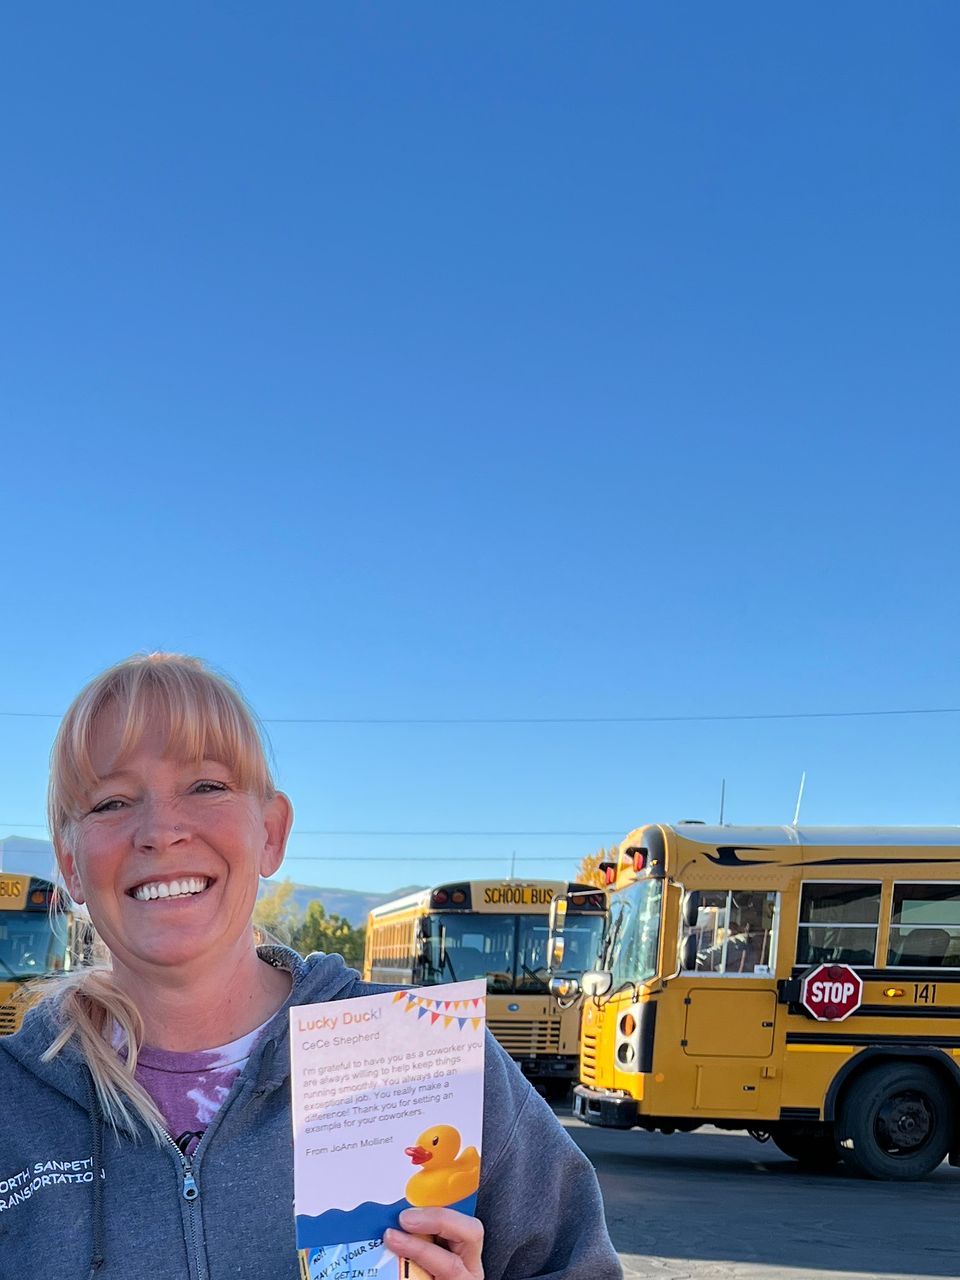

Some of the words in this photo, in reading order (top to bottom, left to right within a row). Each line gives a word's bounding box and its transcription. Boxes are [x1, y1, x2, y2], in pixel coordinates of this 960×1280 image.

[0, 881, 21, 897] BUS
[484, 887, 528, 904] SCHOOL
[531, 888, 554, 905] BUS
[811, 982, 855, 1004] STOP
[913, 984, 937, 1004] 141
[299, 1016, 338, 1031] Lucky
[343, 1008, 382, 1025] Duck!
[302, 1039, 330, 1051] CeCe
[333, 1032, 380, 1046] Shepherd
[318, 1061, 351, 1075] grateful
[353, 1060, 362, 1068] to
[363, 1057, 386, 1066] have
[387, 1055, 404, 1064] you
[406, 1052, 416, 1060] as
[426, 1044, 465, 1057] coworker
[303, 1080, 317, 1088] are
[319, 1073, 350, 1085] always
[352, 1069, 379, 1080] willing
[381, 1067, 390, 1075] to
[391, 1063, 410, 1074] help
[412, 1060, 433, 1071] keep
[435, 1055, 462, 1066] things
[303, 1088, 336, 1100] running
[382, 1078, 400, 1087] You
[402, 1072, 431, 1084] always
[433, 1069, 445, 1079] do
[446, 1068, 458, 1076] an
[303, 1095, 354, 1111] exceptional
[374, 1091, 391, 1100] You
[393, 1086, 417, 1097] really
[418, 1082, 442, 1092] make
[352, 1104, 380, 1115] Thank
[381, 1102, 397, 1112] you
[399, 1098, 411, 1108] for
[413, 1094, 441, 1106] setting
[442, 1092, 454, 1100] an
[304, 1120, 342, 1134] example
[343, 1118, 356, 1128] for
[357, 1115, 378, 1127] your
[305, 1147, 328, 1157] From
[330, 1142, 358, 1153] JoAnn
[329, 1259, 341, 1271] IN
[341, 1245, 367, 1264] YOUR
[368, 1238, 384, 1250] SEA
[334, 1270, 350, 1280] GET
[352, 1269, 365, 1278] IN
